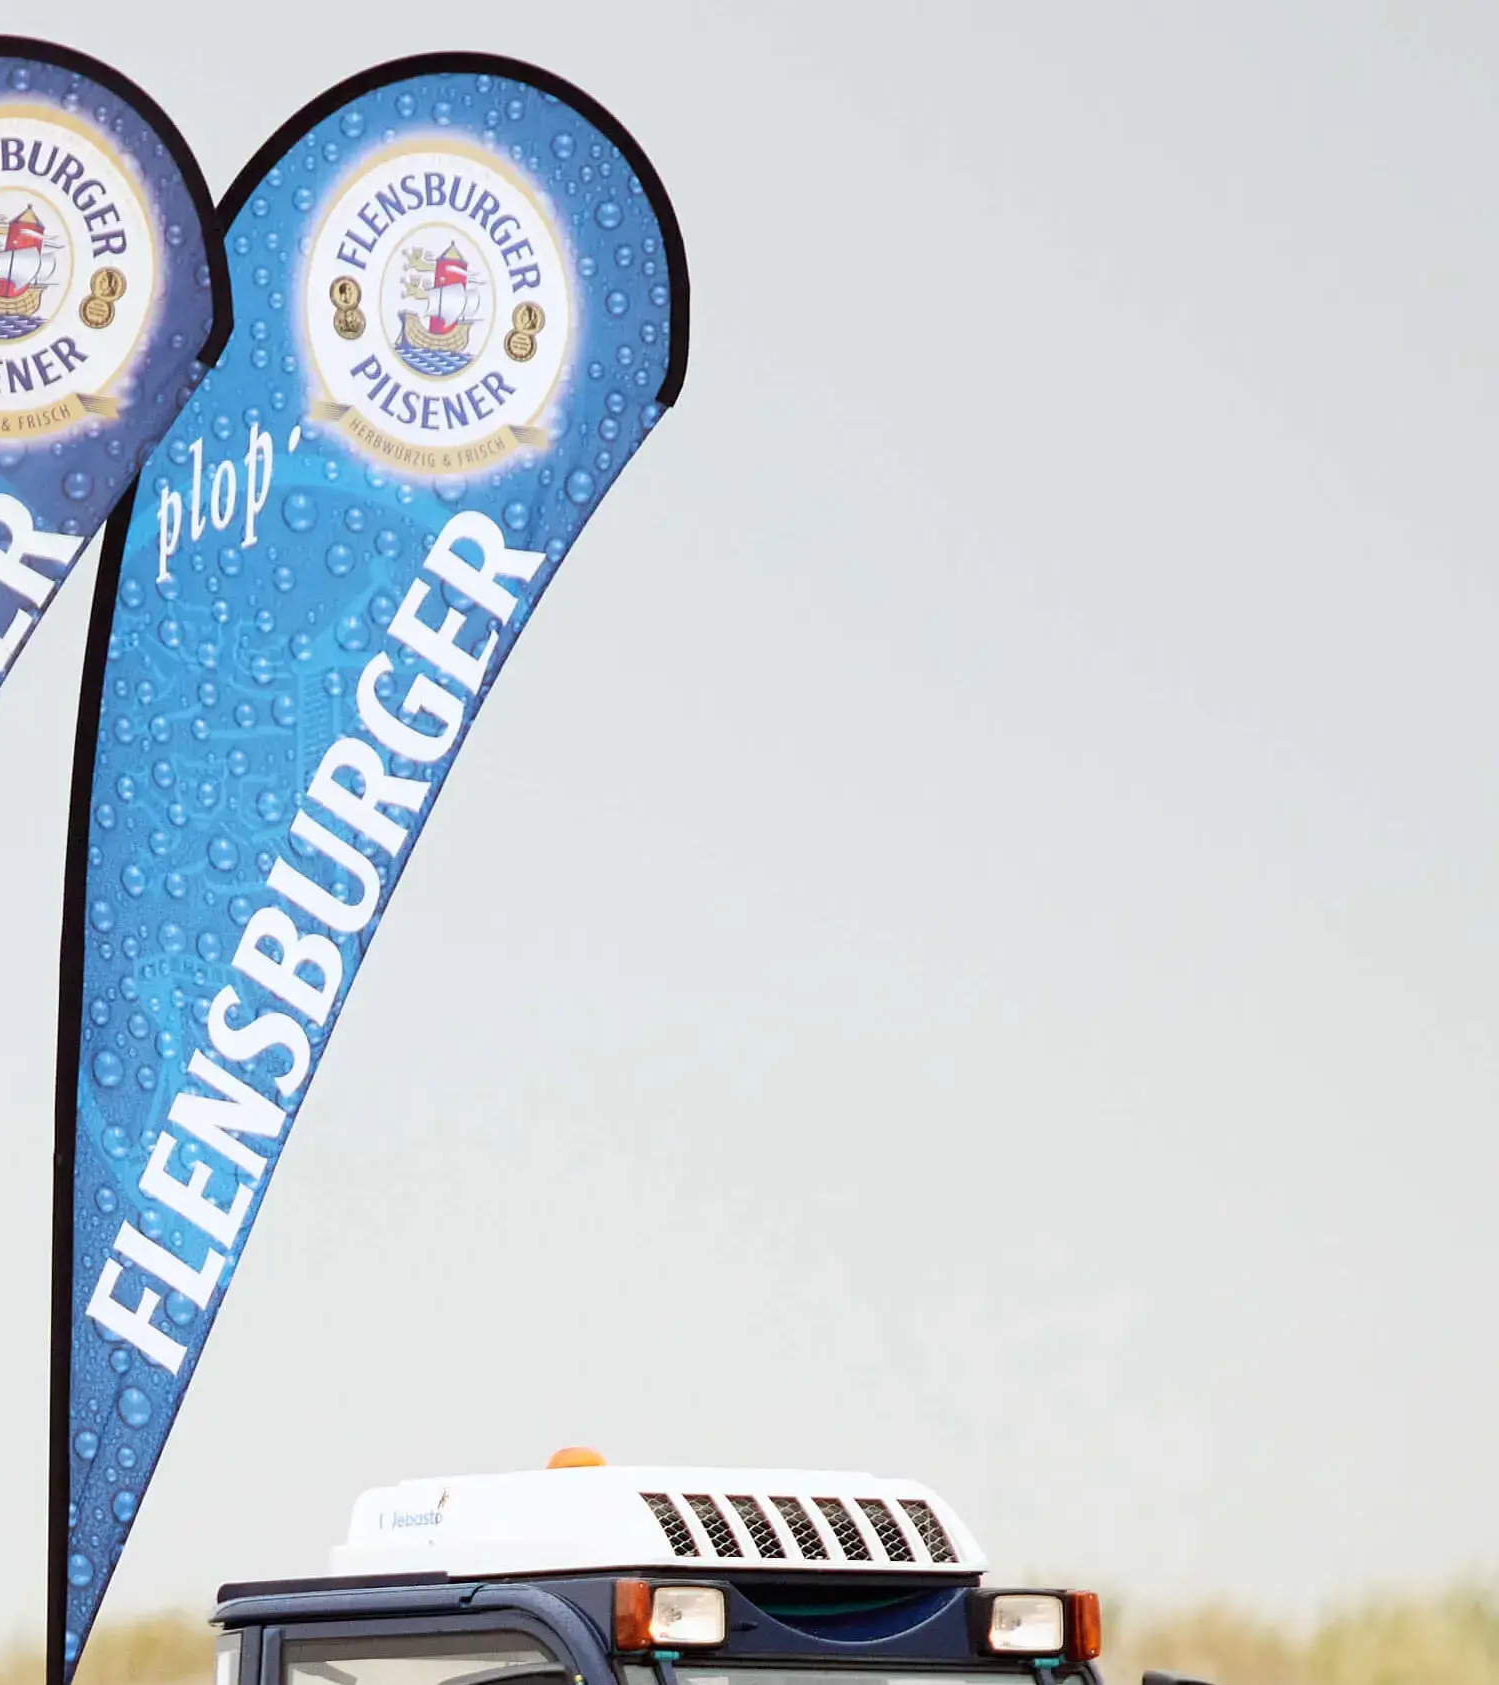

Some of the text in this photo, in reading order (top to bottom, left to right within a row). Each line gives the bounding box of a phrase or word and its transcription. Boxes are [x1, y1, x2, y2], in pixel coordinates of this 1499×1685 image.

[336, 172, 542, 294] FLENSBURGER
[1, 417, 11, 431] &
[18, 403, 72, 430] FRISCH
[349, 353, 517, 431] PILSENER
[457, 436, 506, 468] FRISCH
[86, 510, 546, 1375] FLENSBURGER
